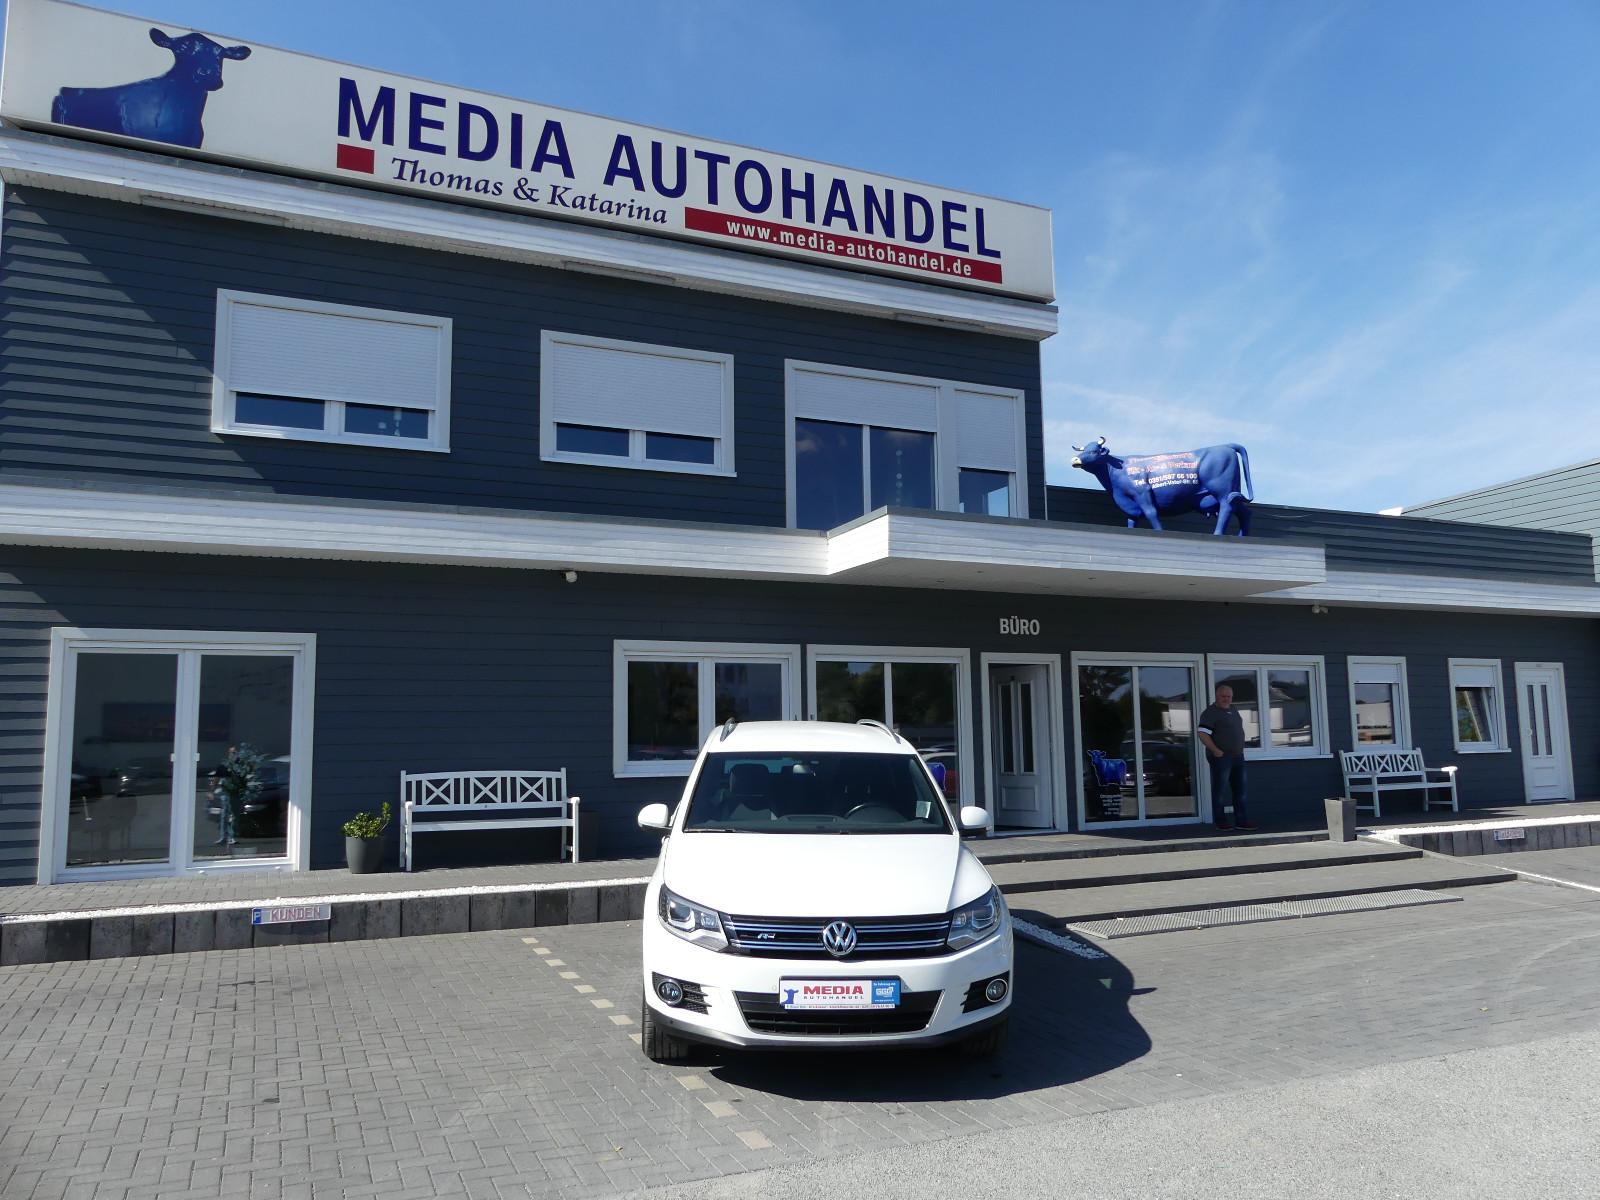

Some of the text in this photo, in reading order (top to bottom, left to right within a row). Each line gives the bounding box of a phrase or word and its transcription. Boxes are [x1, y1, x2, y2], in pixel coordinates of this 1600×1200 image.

[337, 77, 1001, 258] MEDIA AUTOHANDEL
[391, 157, 668, 224] Thomas & Katarina
[726, 219, 972, 277] www.media-autohandel.de
[999, 616, 1040, 636] BÜRO
[271, 906, 320, 922] KUNDEN
[803, 985, 864, 995] MEDIA
